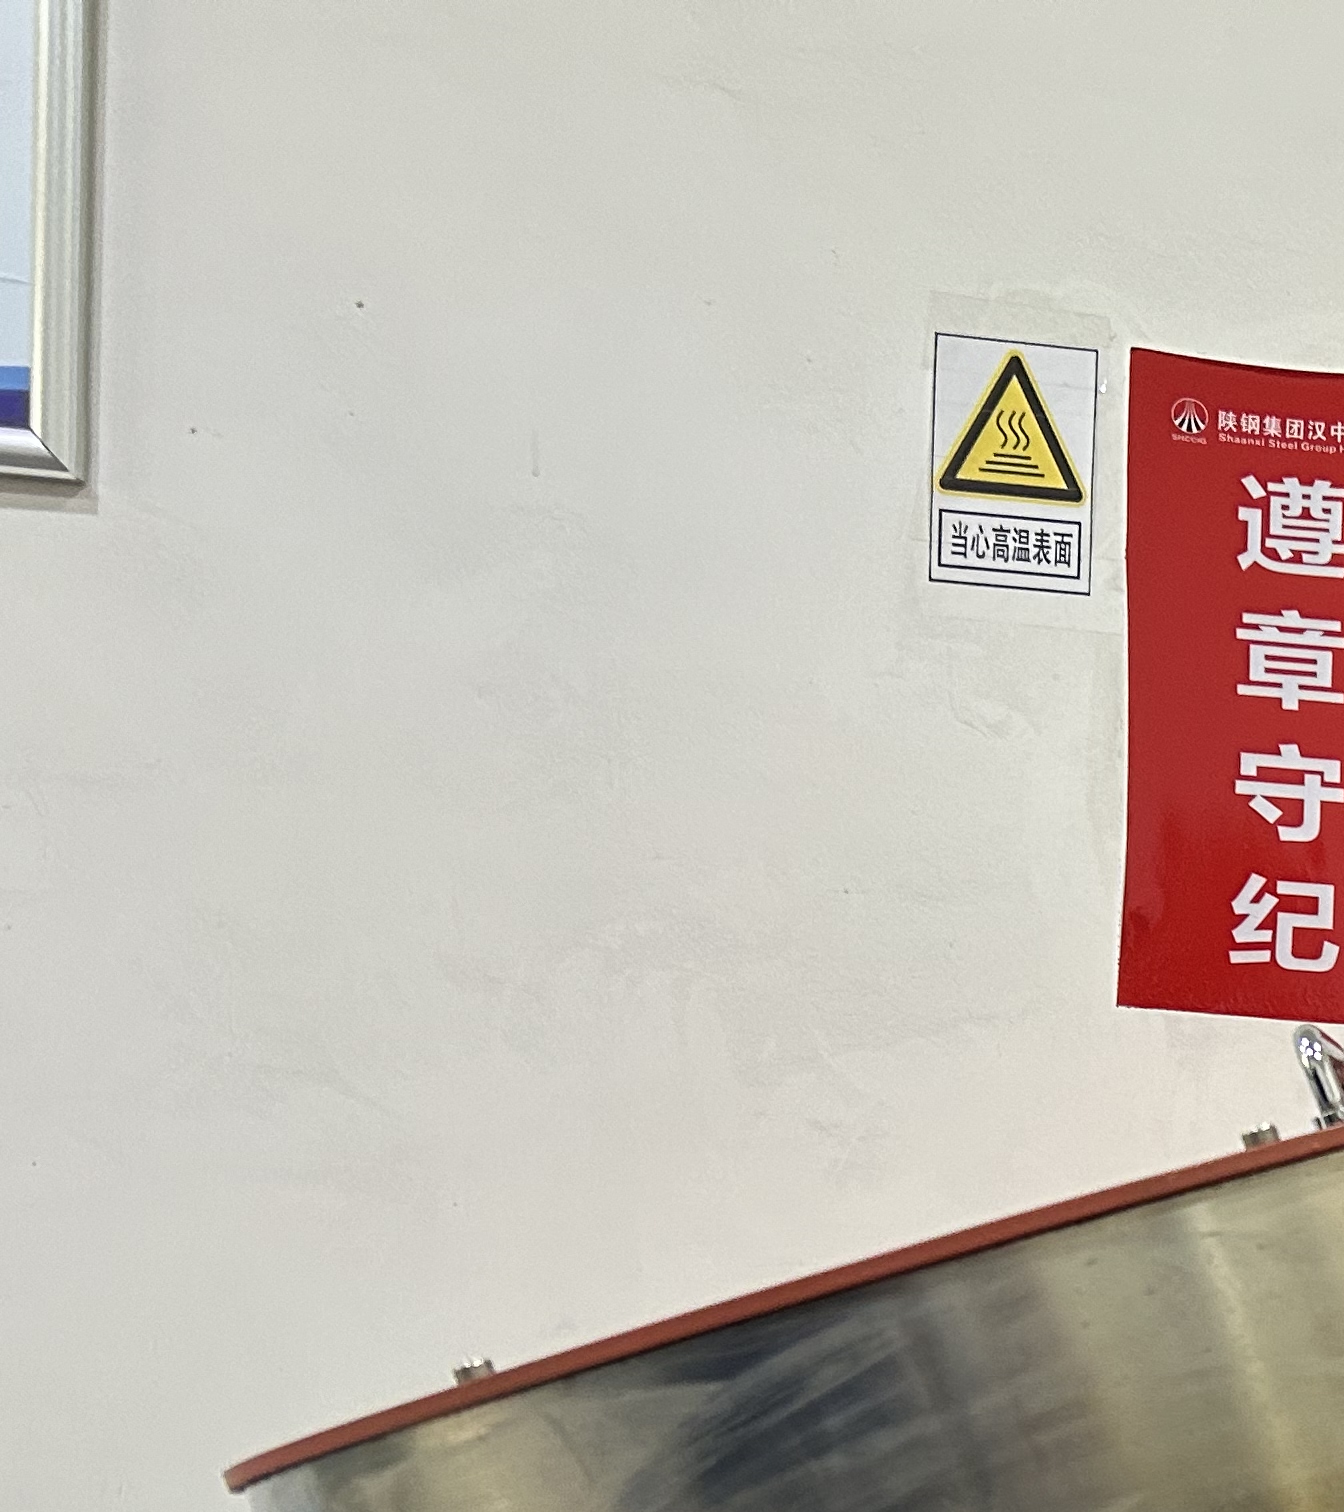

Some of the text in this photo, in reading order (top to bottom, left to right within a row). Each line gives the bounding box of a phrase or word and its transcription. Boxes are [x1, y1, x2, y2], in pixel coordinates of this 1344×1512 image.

[1218, 433, 1265, 447] Shaanxi
[1268, 438, 1298, 450] Steel
[1301, 441, 1337, 454] Group
[951, 520, 1074, 568] 当心高温表面
